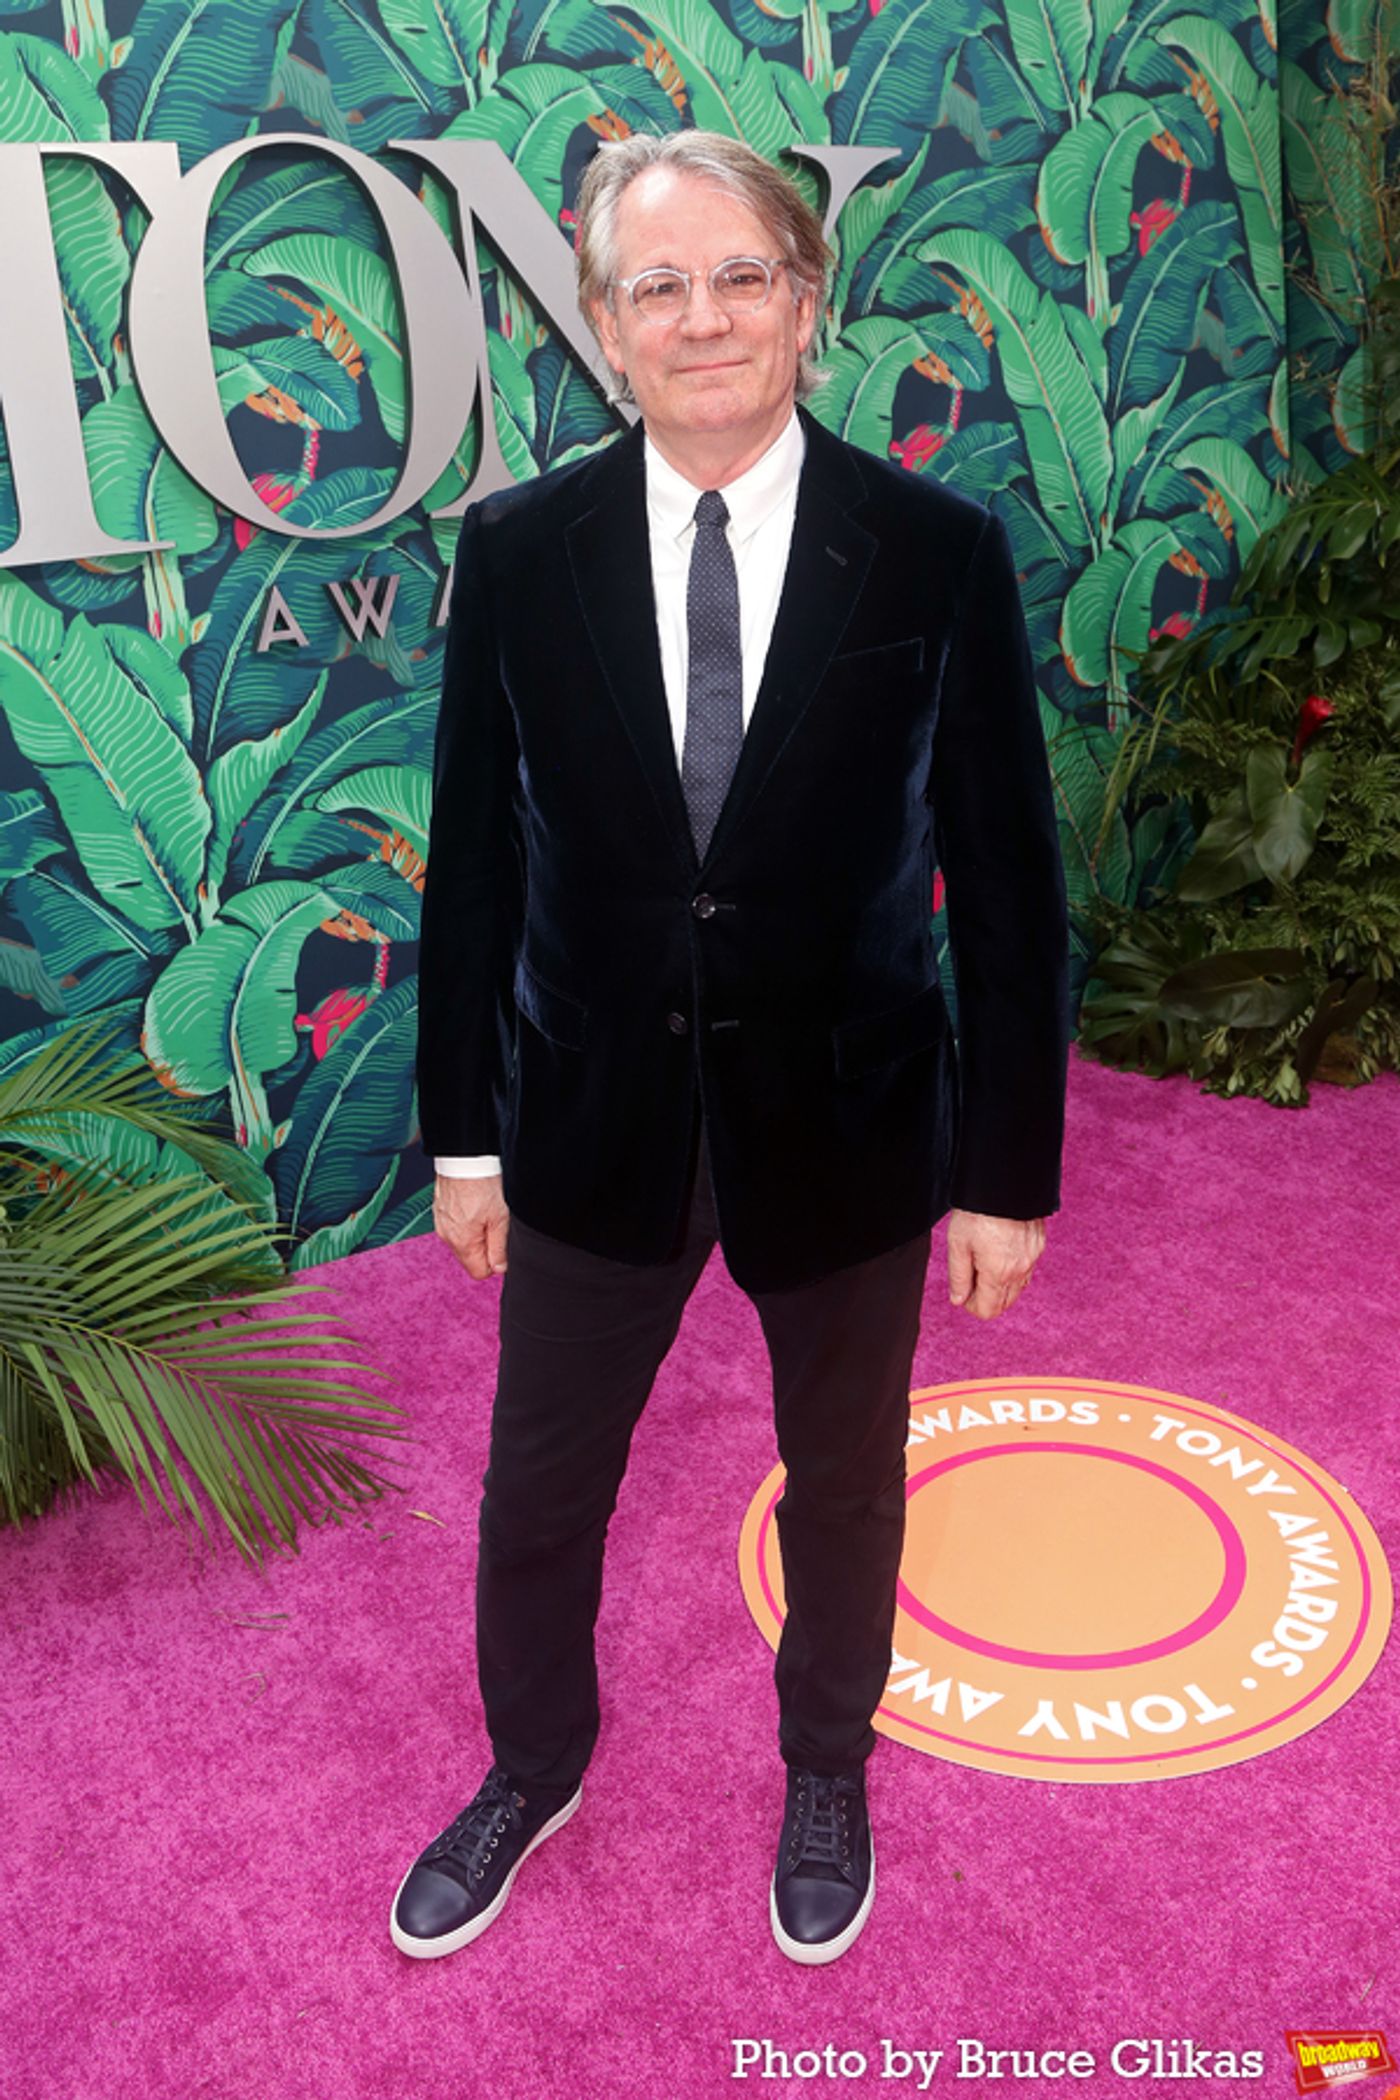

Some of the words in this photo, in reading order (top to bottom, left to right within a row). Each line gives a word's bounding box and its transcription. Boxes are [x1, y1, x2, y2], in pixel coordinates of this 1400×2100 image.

[1150, 1414, 1298, 1497] TONY
[1249, 1510, 1341, 1678] AWARDS
[1017, 1683, 1236, 1742] TONY
